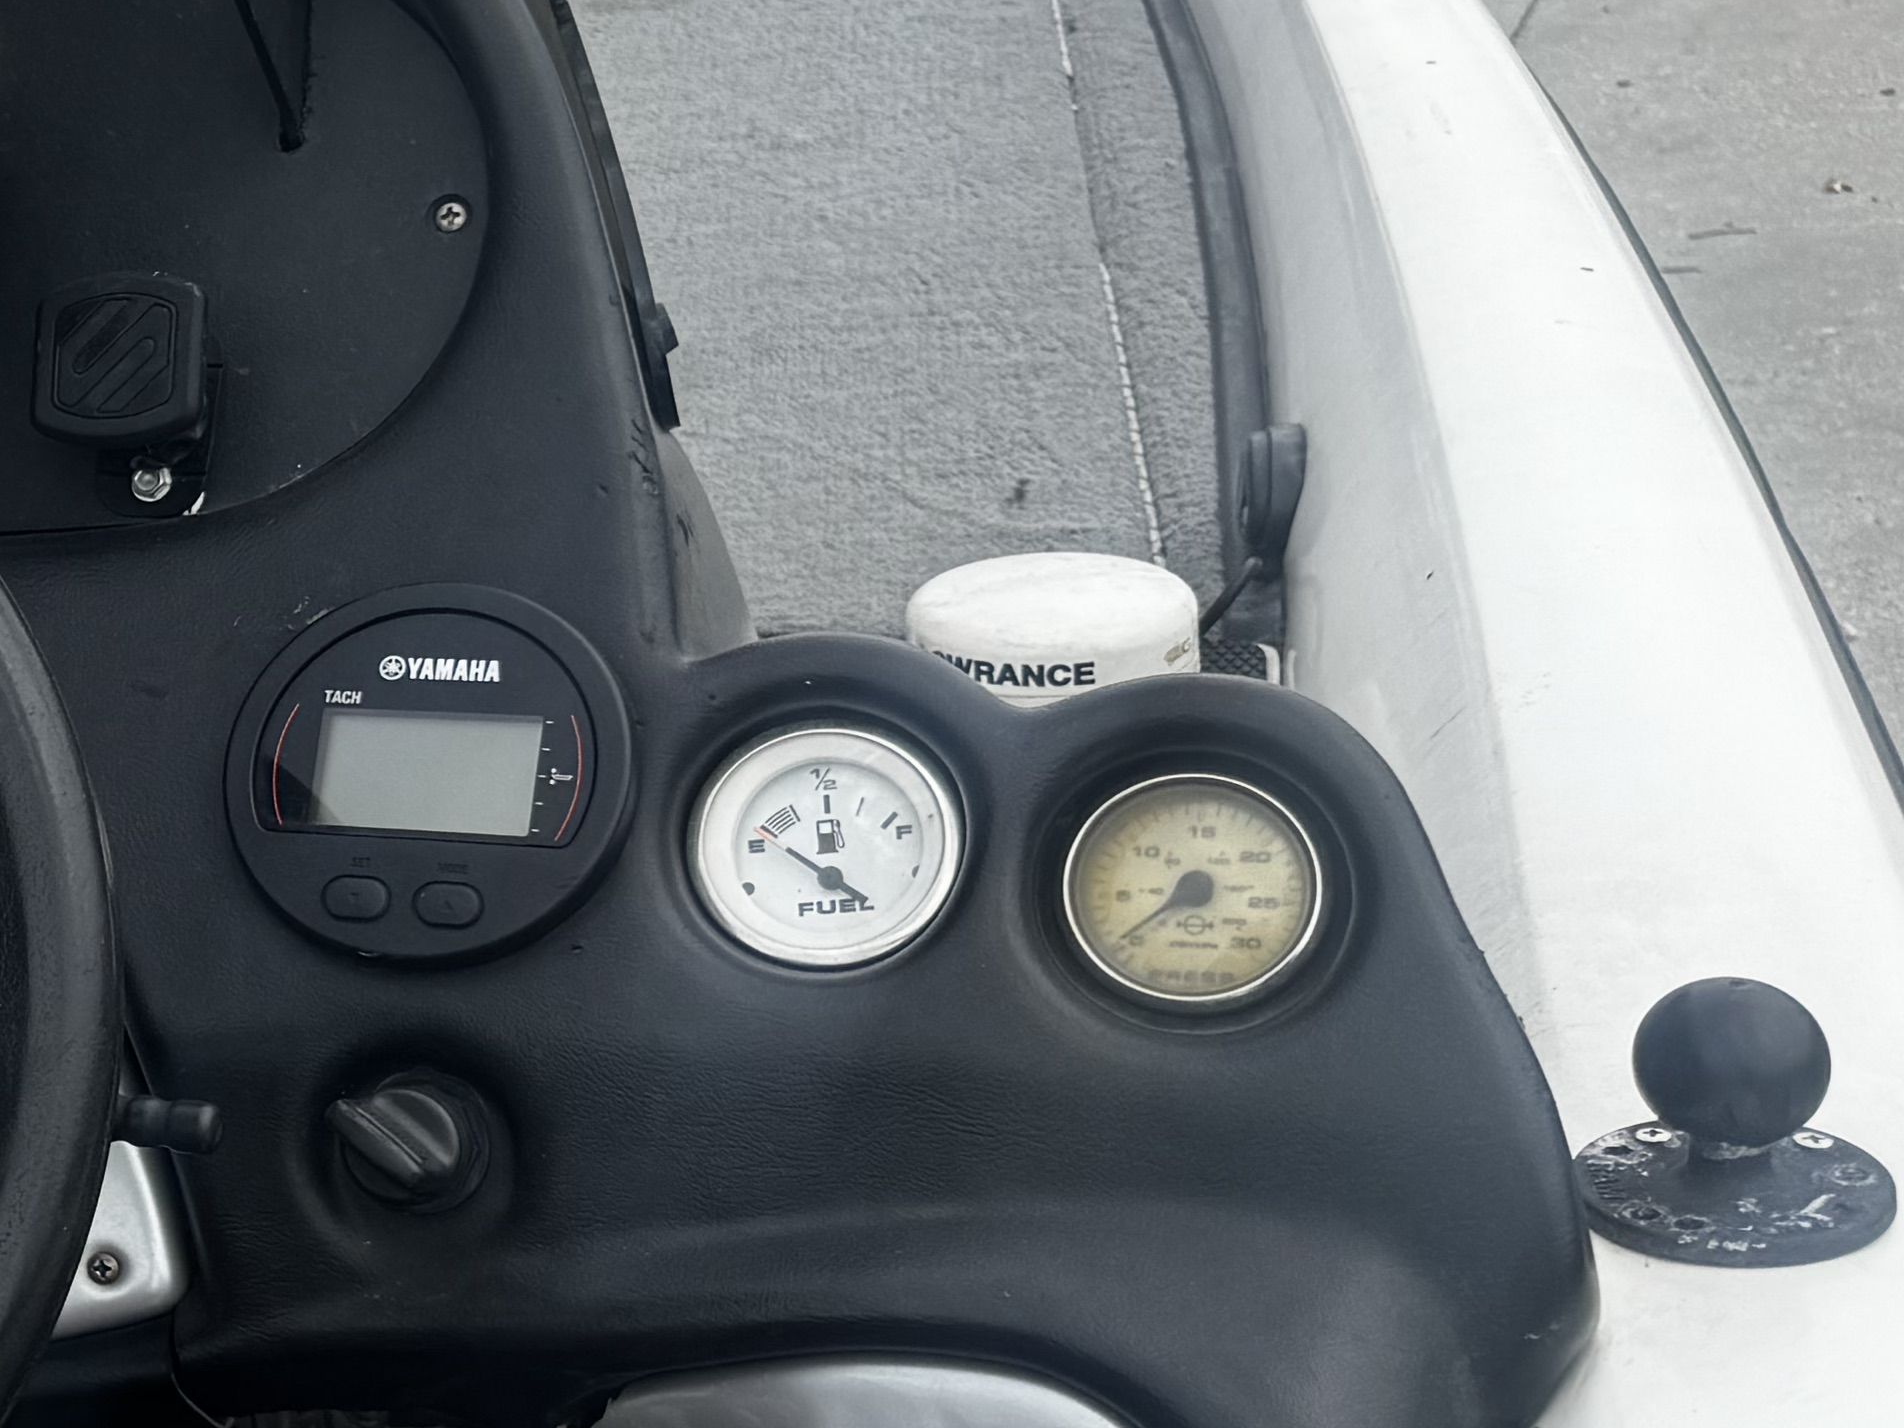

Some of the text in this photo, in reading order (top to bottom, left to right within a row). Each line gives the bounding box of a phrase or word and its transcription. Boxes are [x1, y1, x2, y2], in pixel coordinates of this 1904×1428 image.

[408, 657, 500, 683] YAMAHA
[929, 650, 1096, 687] WRANCE
[324, 689, 363, 705] TACH
[896, 824, 912, 840] F
[1189, 824, 1217, 839] 15
[748, 838, 766, 854] E
[1133, 845, 1160, 859] 10
[1240, 850, 1272, 864] 20
[797, 897, 875, 917] FUEL
[1247, 896, 1280, 910] 25
[1229, 936, 1262, 950] 30
